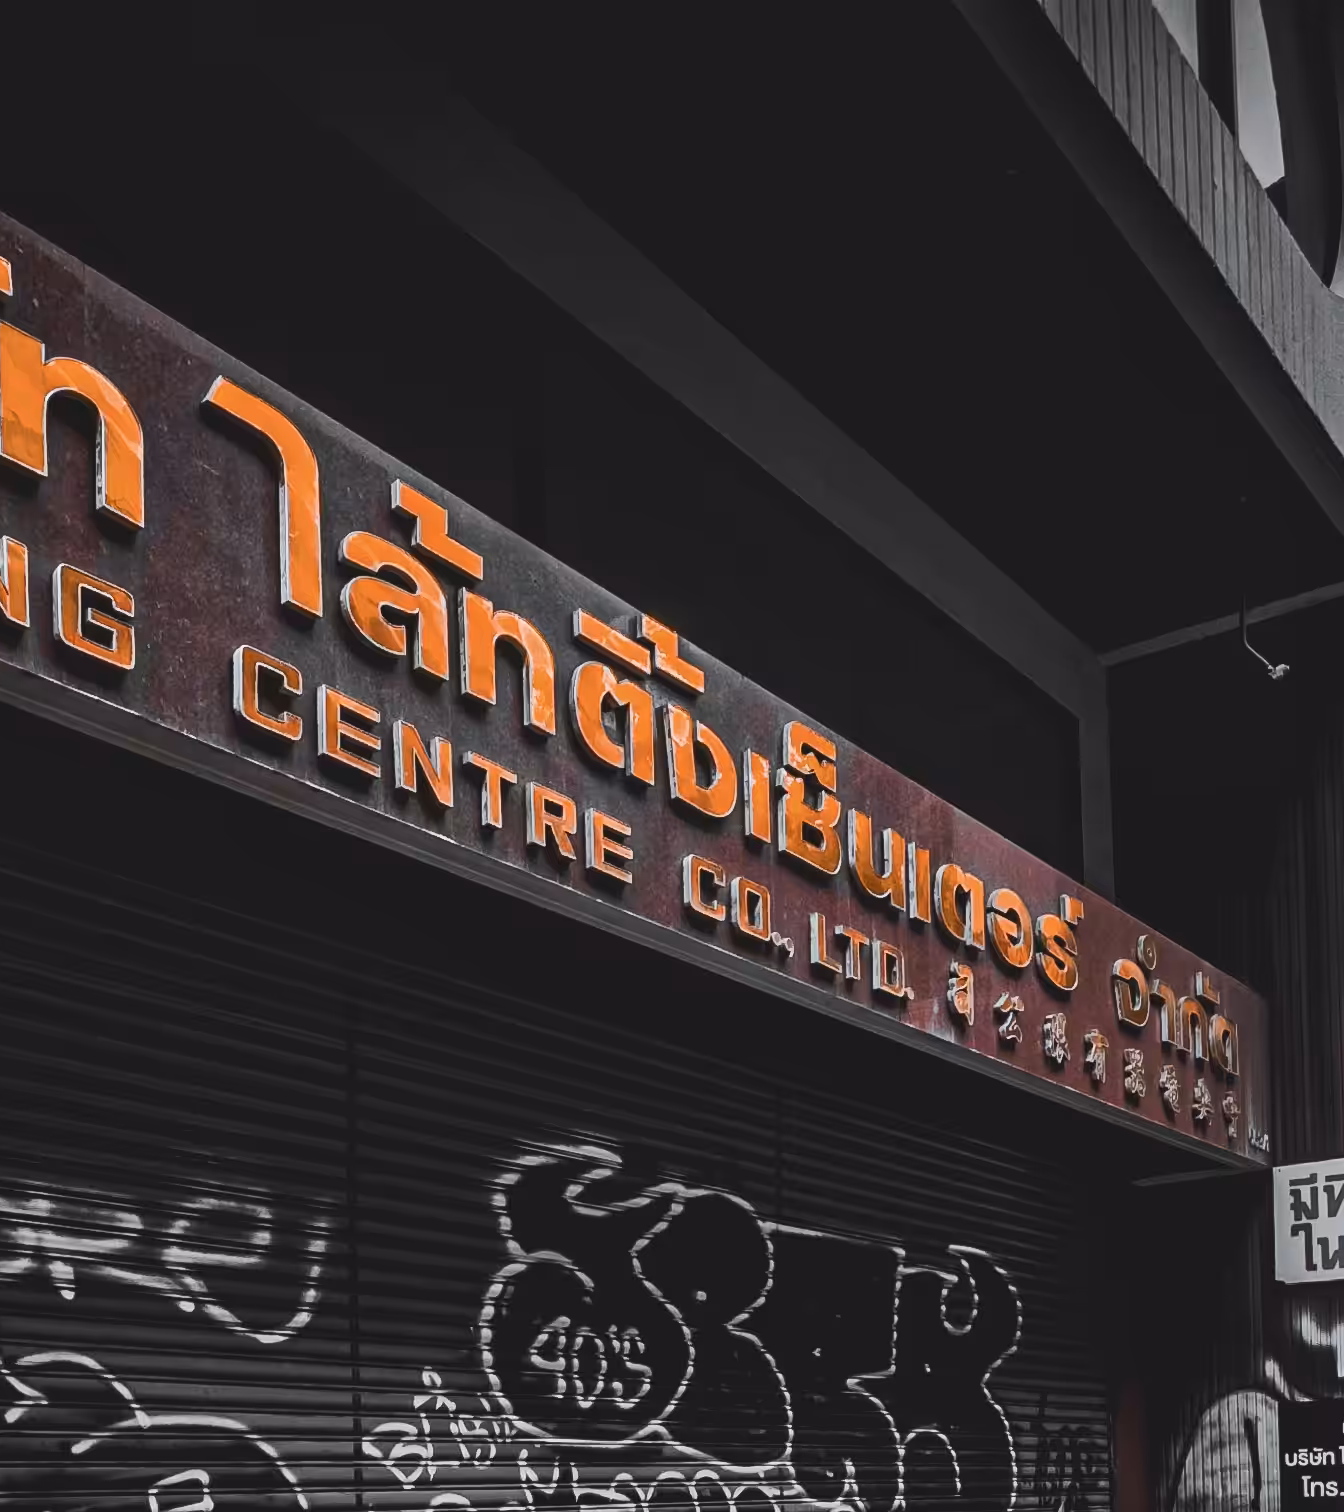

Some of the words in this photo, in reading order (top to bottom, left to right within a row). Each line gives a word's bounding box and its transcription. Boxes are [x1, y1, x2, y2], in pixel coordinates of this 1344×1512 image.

[233, 645, 633, 884] CENTRE
[809, 911, 915, 1000] LTD.
[1112, 934, 1239, 1075] จำกัด
[1284, 1447, 1335, 1467] บริษัท
